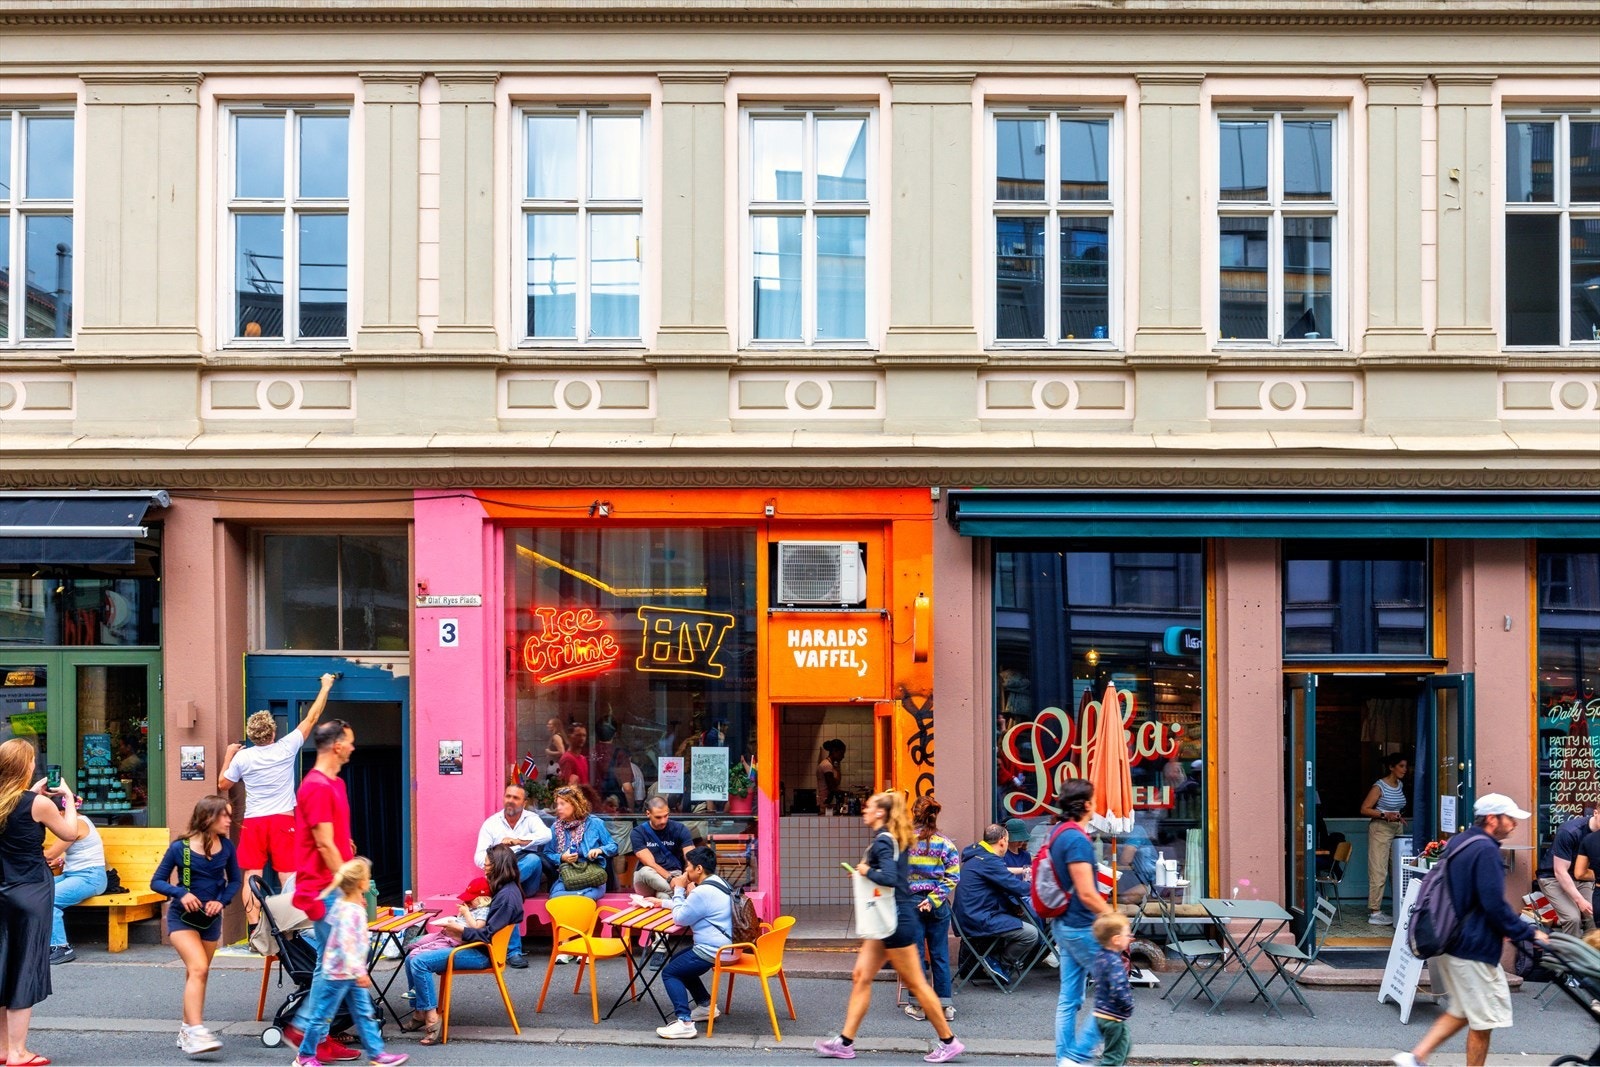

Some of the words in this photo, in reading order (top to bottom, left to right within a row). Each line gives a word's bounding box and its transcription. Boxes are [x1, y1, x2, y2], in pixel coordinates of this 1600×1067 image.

[443, 596, 459, 605] Ryes
[535, 607, 602, 642] Ice
[442, 622, 456, 643] 3
[787, 627, 868, 648] HARALDS
[524, 634, 619, 672] Crime
[793, 649, 859, 668] VAFFEL
[1548, 700, 1582, 723] Daily
[1549, 735, 1580, 746] PATTY
[1583, 735, 1600, 746] ME
[1549, 747, 1577, 758] FRIED
[1549, 758, 1568, 769] HOT
[1549, 770, 1591, 780] GRILLED
[1549, 781, 1577, 791] COLD
[1133, 785, 1171, 807] ELI
[1549, 792, 1571, 802] HOT
[1549, 803, 1583, 813] SODAS
[1549, 814, 1565, 824] ICE
